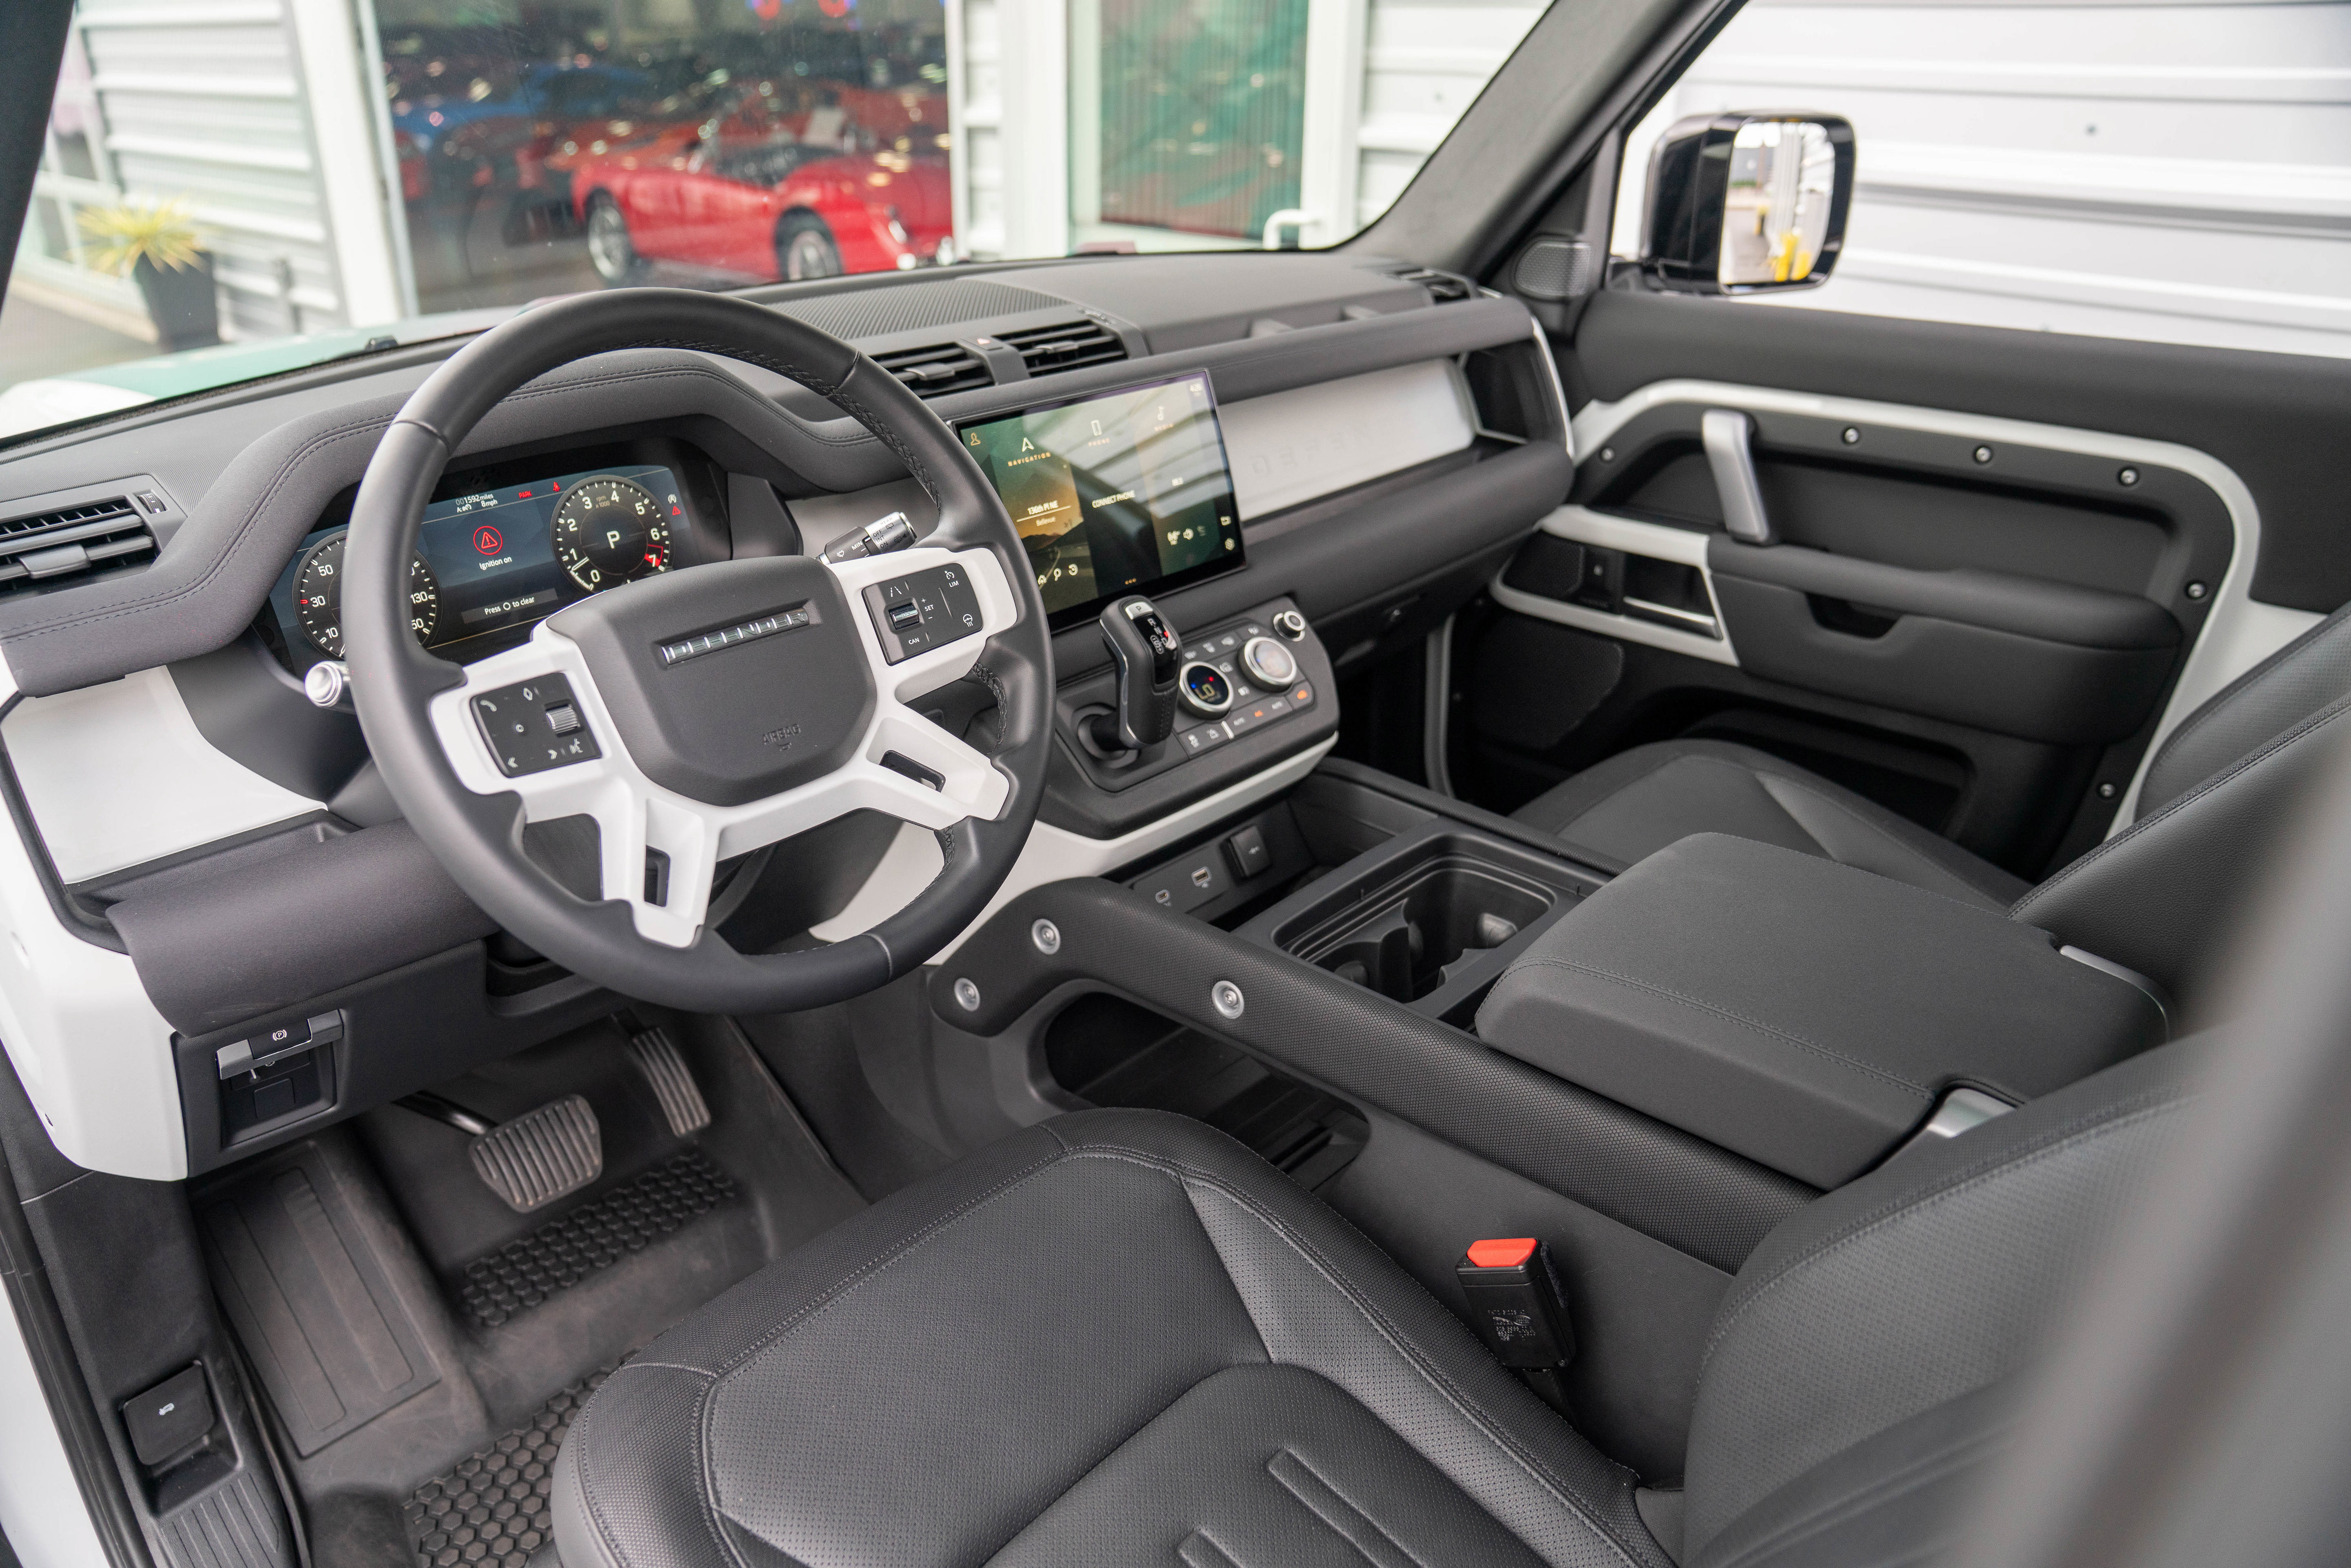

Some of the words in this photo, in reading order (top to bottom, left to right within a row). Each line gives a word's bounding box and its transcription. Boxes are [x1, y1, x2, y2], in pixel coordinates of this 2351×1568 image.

[1008, 452, 1051, 467] NAVIGATION
[518, 491, 532, 499] PARK
[611, 490, 619, 502] 4
[1092, 495, 1117, 508] CONNECT
[1116, 490, 1135, 502] PHONE
[582, 496, 592, 509] 3
[635, 502, 645, 515] 5
[1027, 505, 1044, 515] 136th
[1049, 500, 1059, 509] NE
[567, 518, 578, 531] 2
[1036, 516, 1056, 526] Bellevue
[607, 531, 620, 549] P
[651, 528, 660, 540] 6
[851, 541, 863, 550] MIN
[570, 548, 577, 560] 1
[649, 554, 656, 567] 7
[318, 564, 333, 576] 50
[479, 558, 503, 571] Ignition
[590, 570, 600, 582] 0
[310, 595, 326, 607] 30
[410, 591, 428, 604] 130
[484, 606, 501, 615] Press
[520, 597, 534, 606] clear
[411, 618, 424, 630] 50
[325, 627, 338, 638] 10
[668, 613, 806, 659] DEFENDER
[762, 724, 801, 744] AIRBAG
